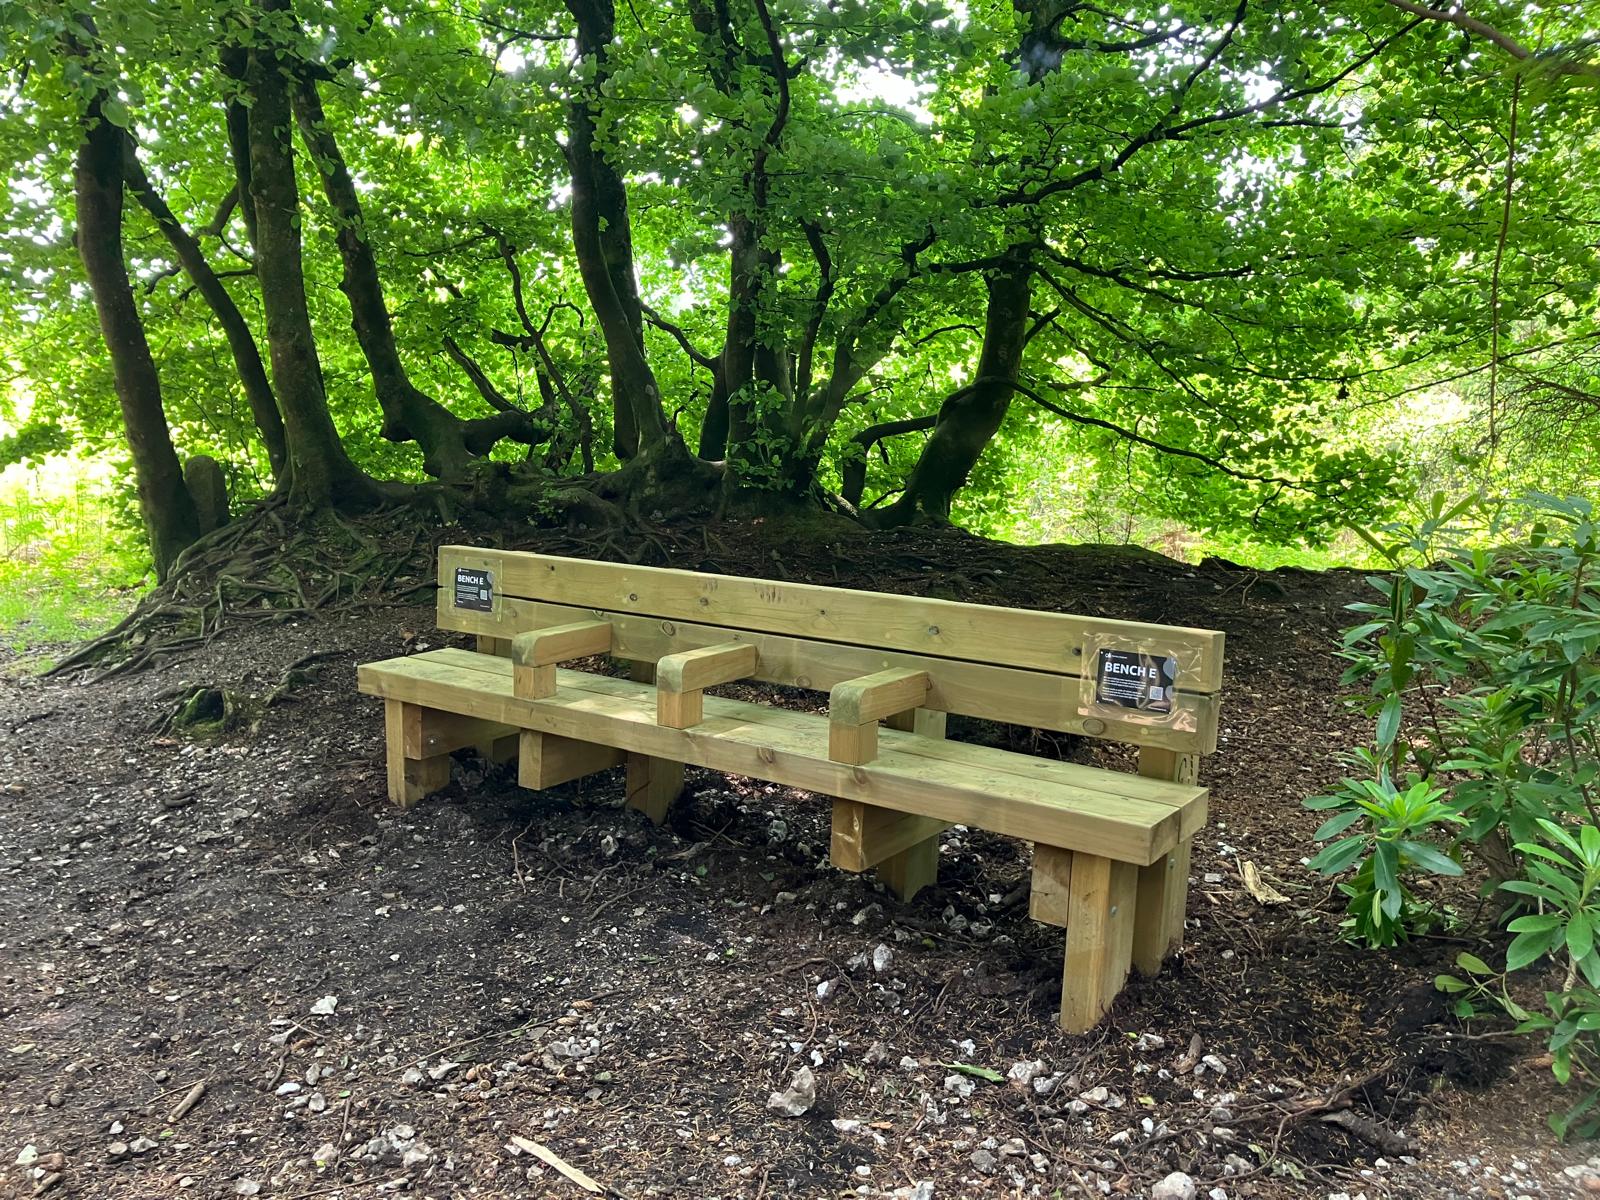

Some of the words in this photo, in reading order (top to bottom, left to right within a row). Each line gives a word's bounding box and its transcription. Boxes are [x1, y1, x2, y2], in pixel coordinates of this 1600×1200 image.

[457, 574, 478, 584] BENCH
[479, 577, 484, 585] E
[1105, 662, 1146, 677] BENCH
[1149, 668, 1157, 678] E
